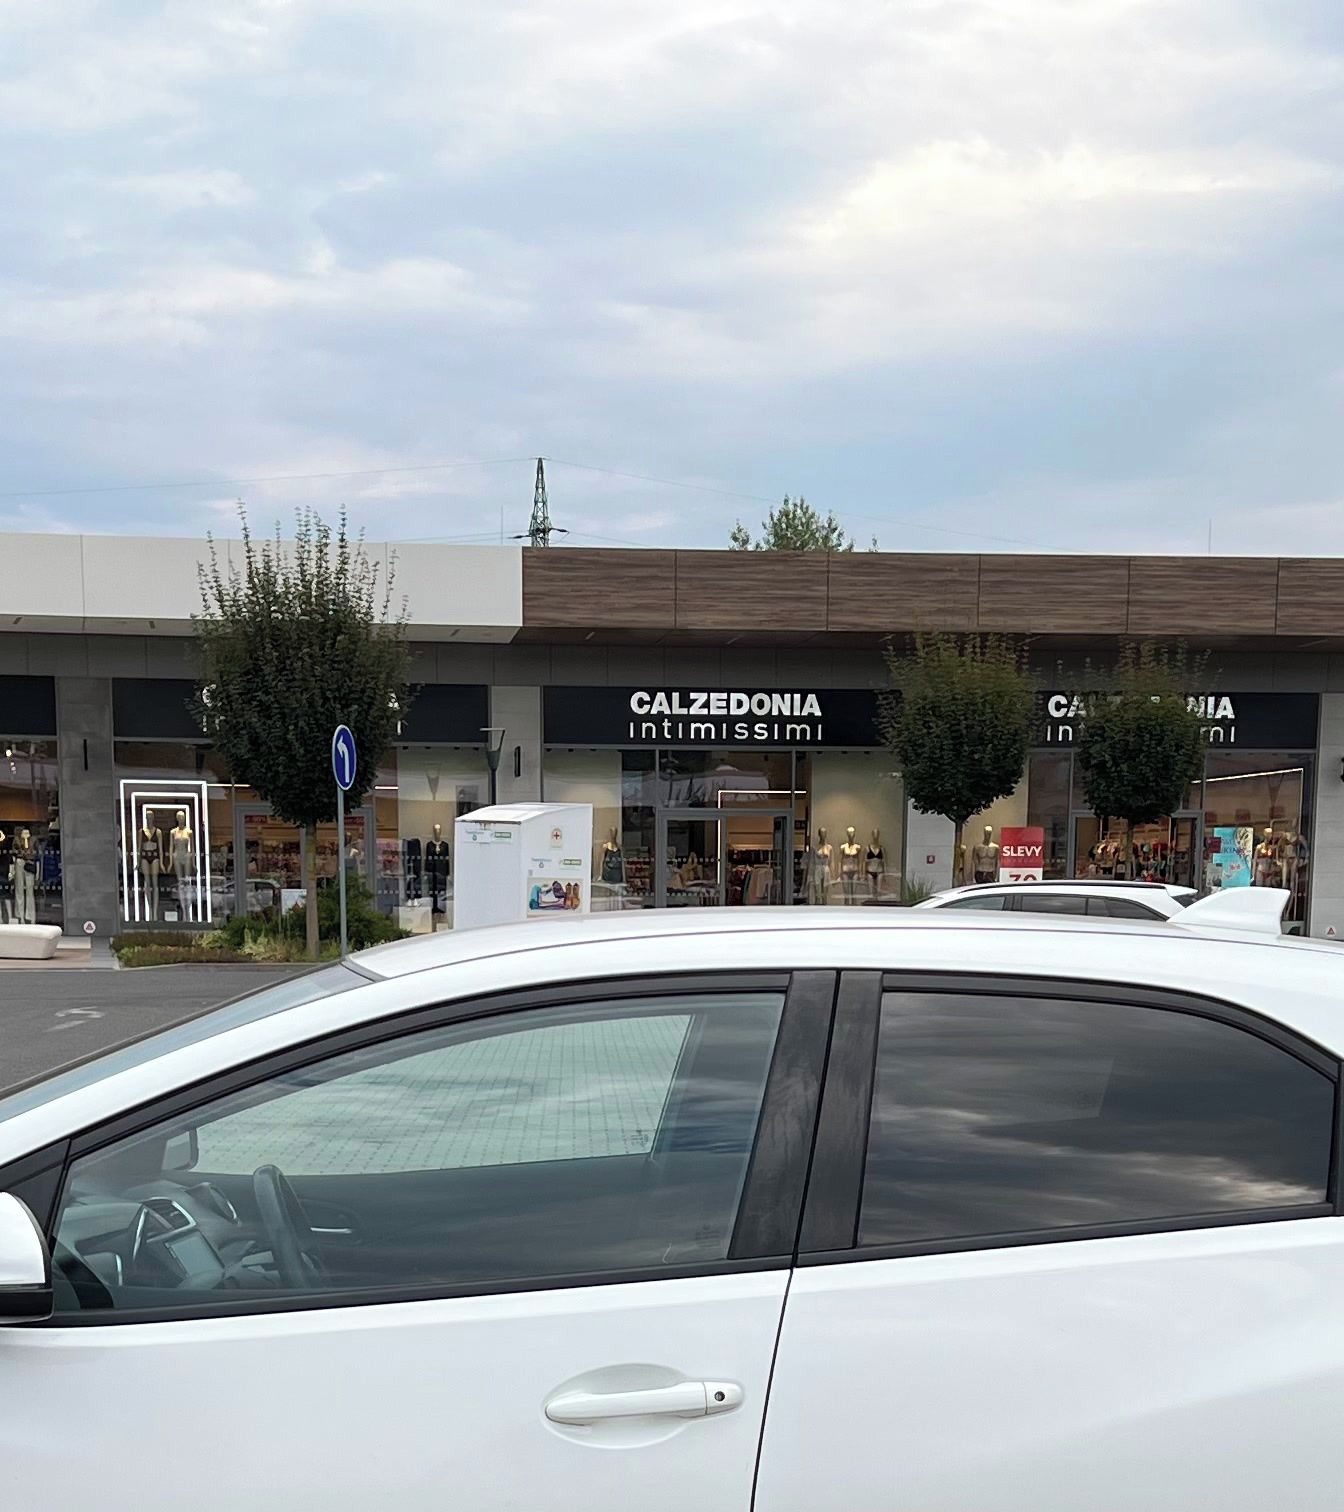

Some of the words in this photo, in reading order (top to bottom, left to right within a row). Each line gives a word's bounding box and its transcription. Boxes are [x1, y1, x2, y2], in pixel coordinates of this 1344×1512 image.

[629, 691, 823, 717] CALZEDONIA
[1047, 694, 1236, 719] CANIA
[629, 718, 823, 741] intimissimi
[1002, 845, 1042, 857] SLEVY
